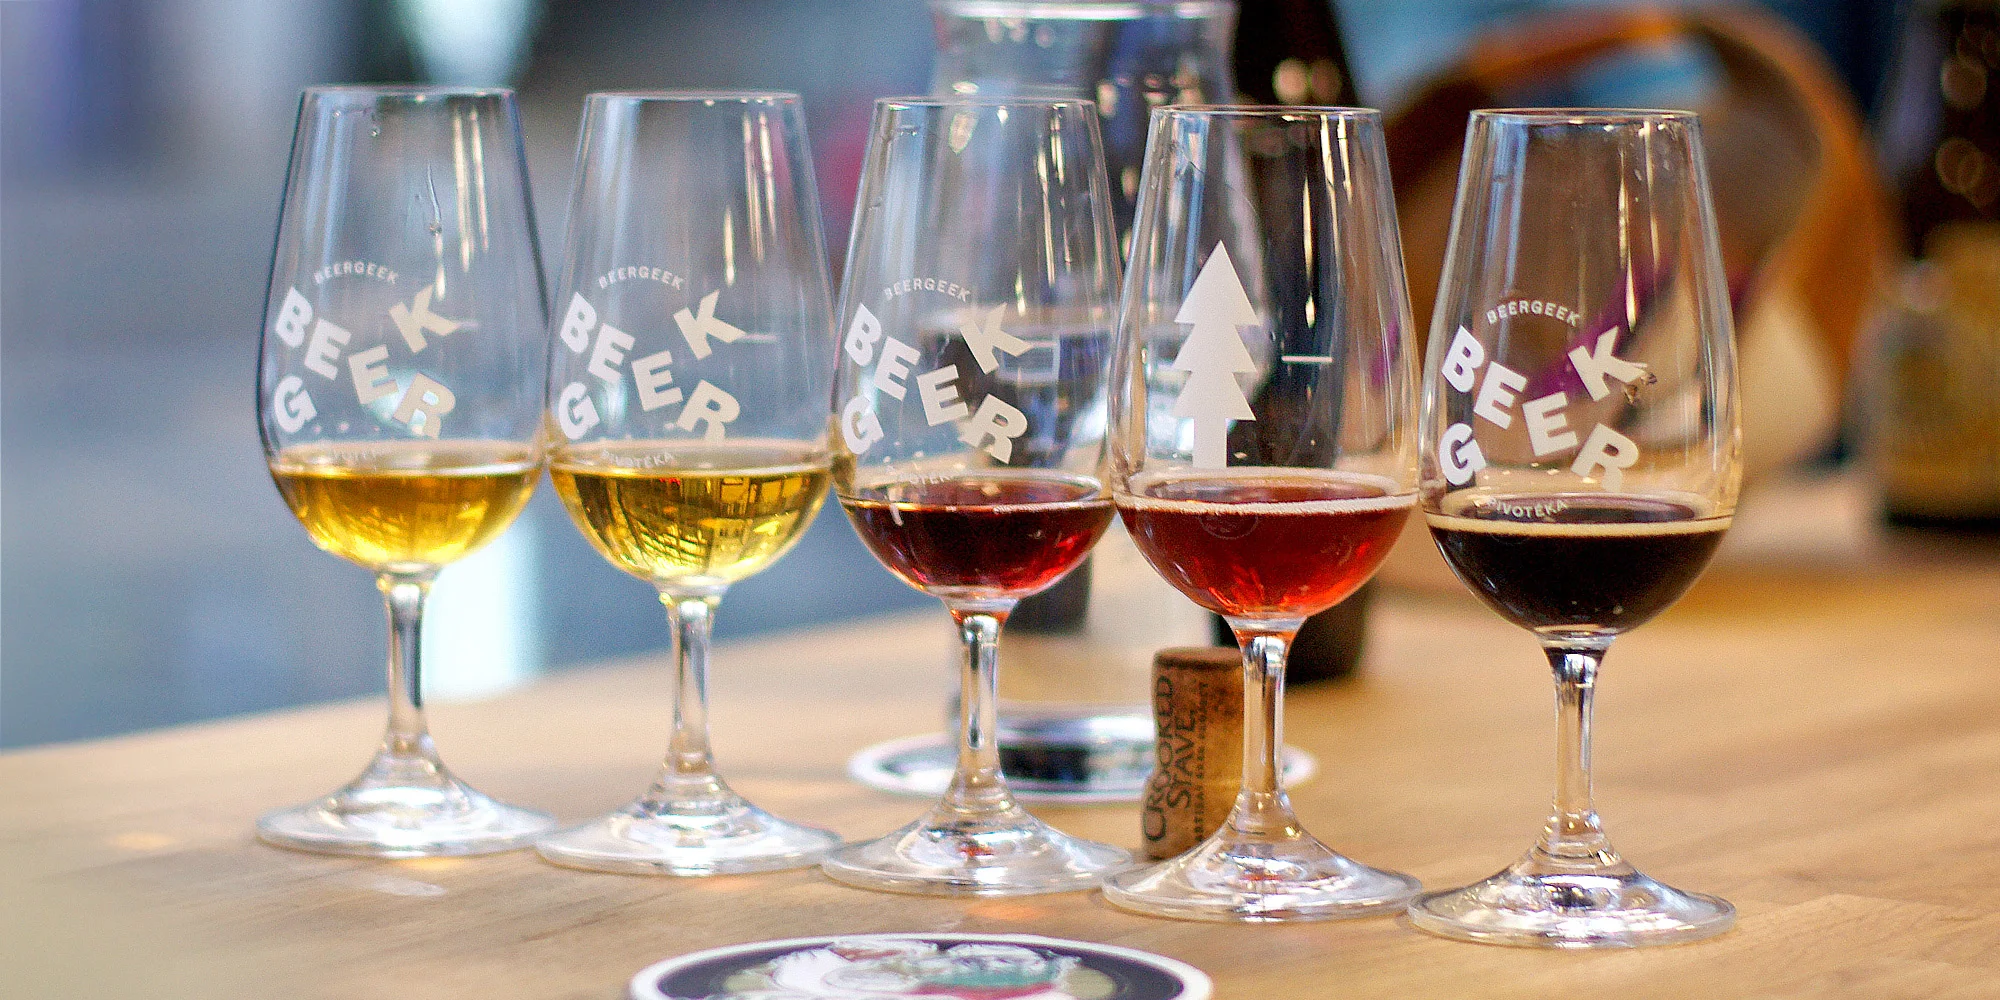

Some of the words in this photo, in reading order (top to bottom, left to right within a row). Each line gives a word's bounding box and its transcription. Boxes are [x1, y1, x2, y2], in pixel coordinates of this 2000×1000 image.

[314, 261, 399, 284] BEERGEEK
[599, 266, 684, 290] BEERGEEK
[883, 278, 970, 302] BEERGEEK
[1487, 300, 1580, 327] BEERGEEK
[1142, 675, 1174, 842] CROOKED
[1166, 709, 1196, 810] STAVE
